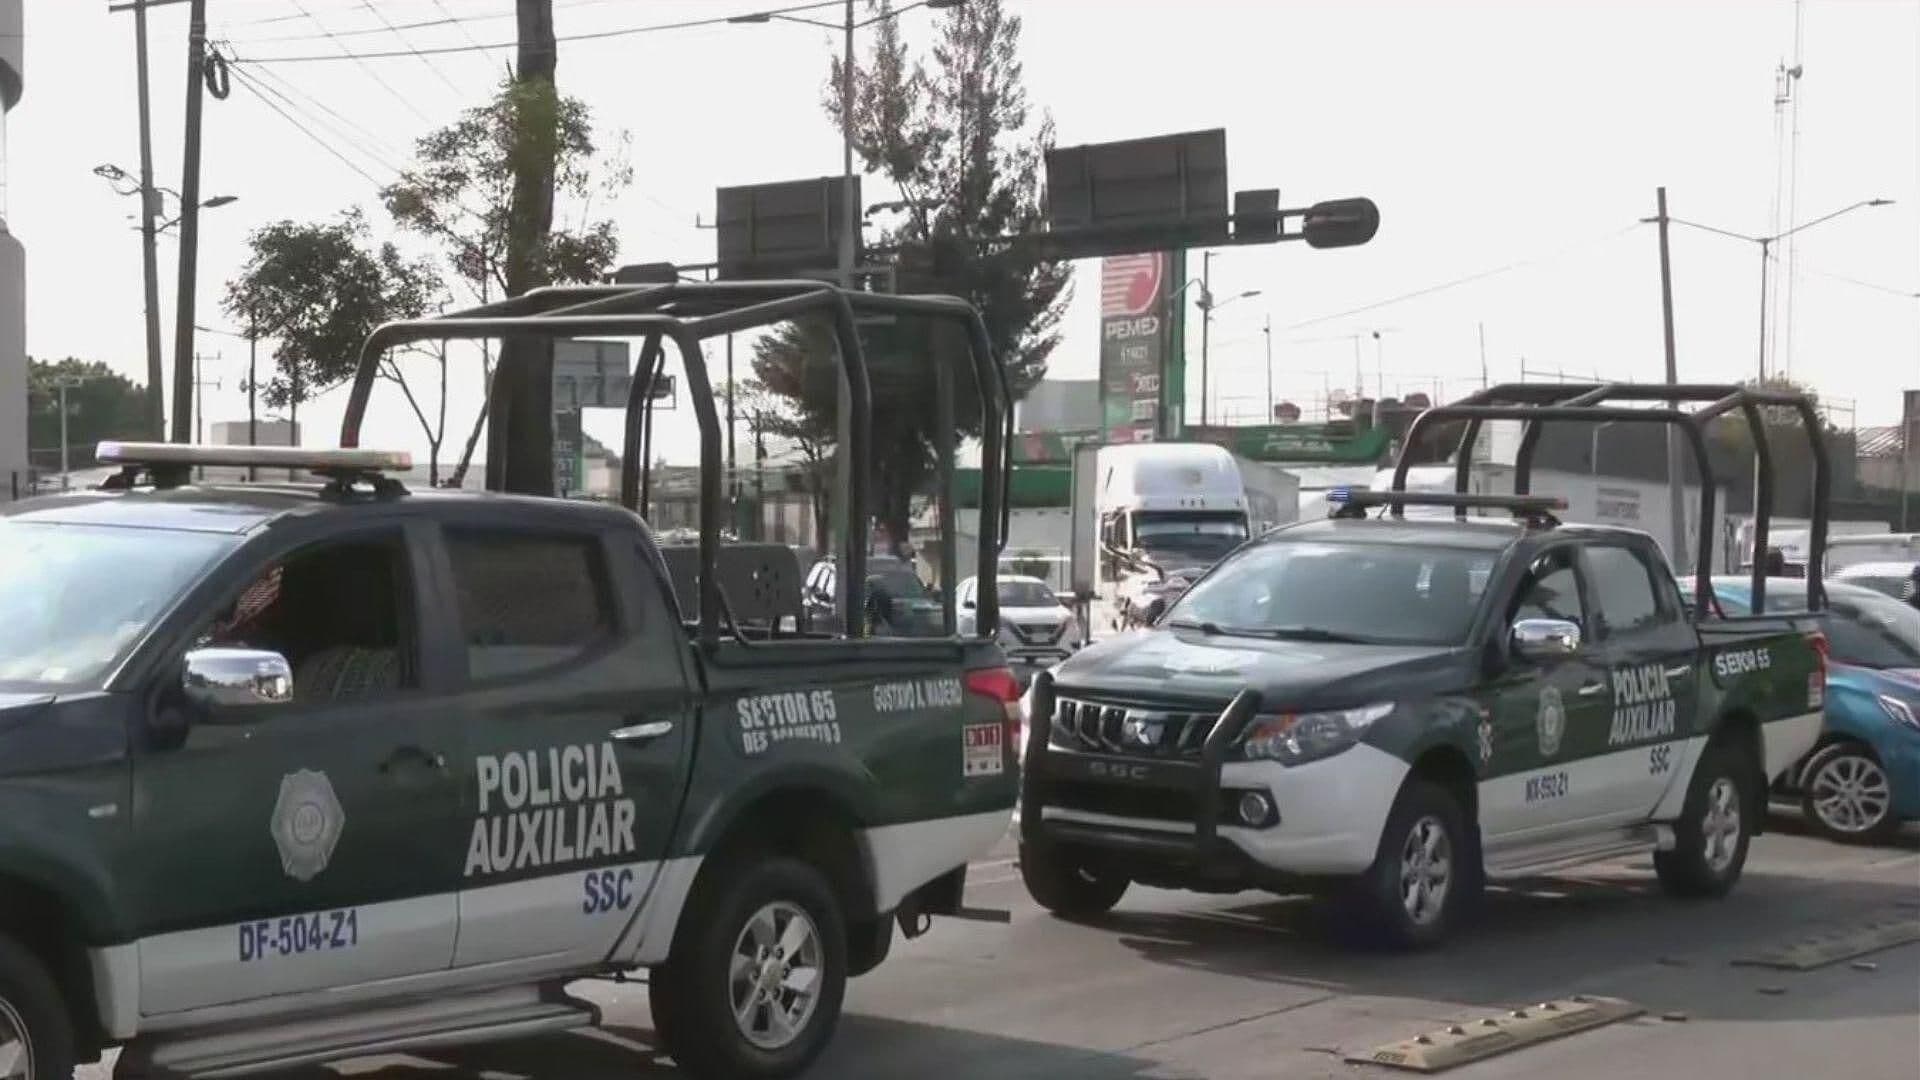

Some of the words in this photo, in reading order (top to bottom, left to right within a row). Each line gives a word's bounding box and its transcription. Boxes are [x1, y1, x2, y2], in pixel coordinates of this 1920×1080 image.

[1612, 664, 1671, 706] POLICIA
[737, 692, 812, 729] SECTOR
[811, 690, 837, 721] 65
[1608, 700, 1675, 745] AUXILIAR
[476, 741, 623, 814] POLICIA
[1649, 744, 1671, 776] SSC
[463, 797, 636, 877] AUXILIAR
[583, 868, 634, 914] SSC
[239, 908, 358, 961] DF-504-Z1
